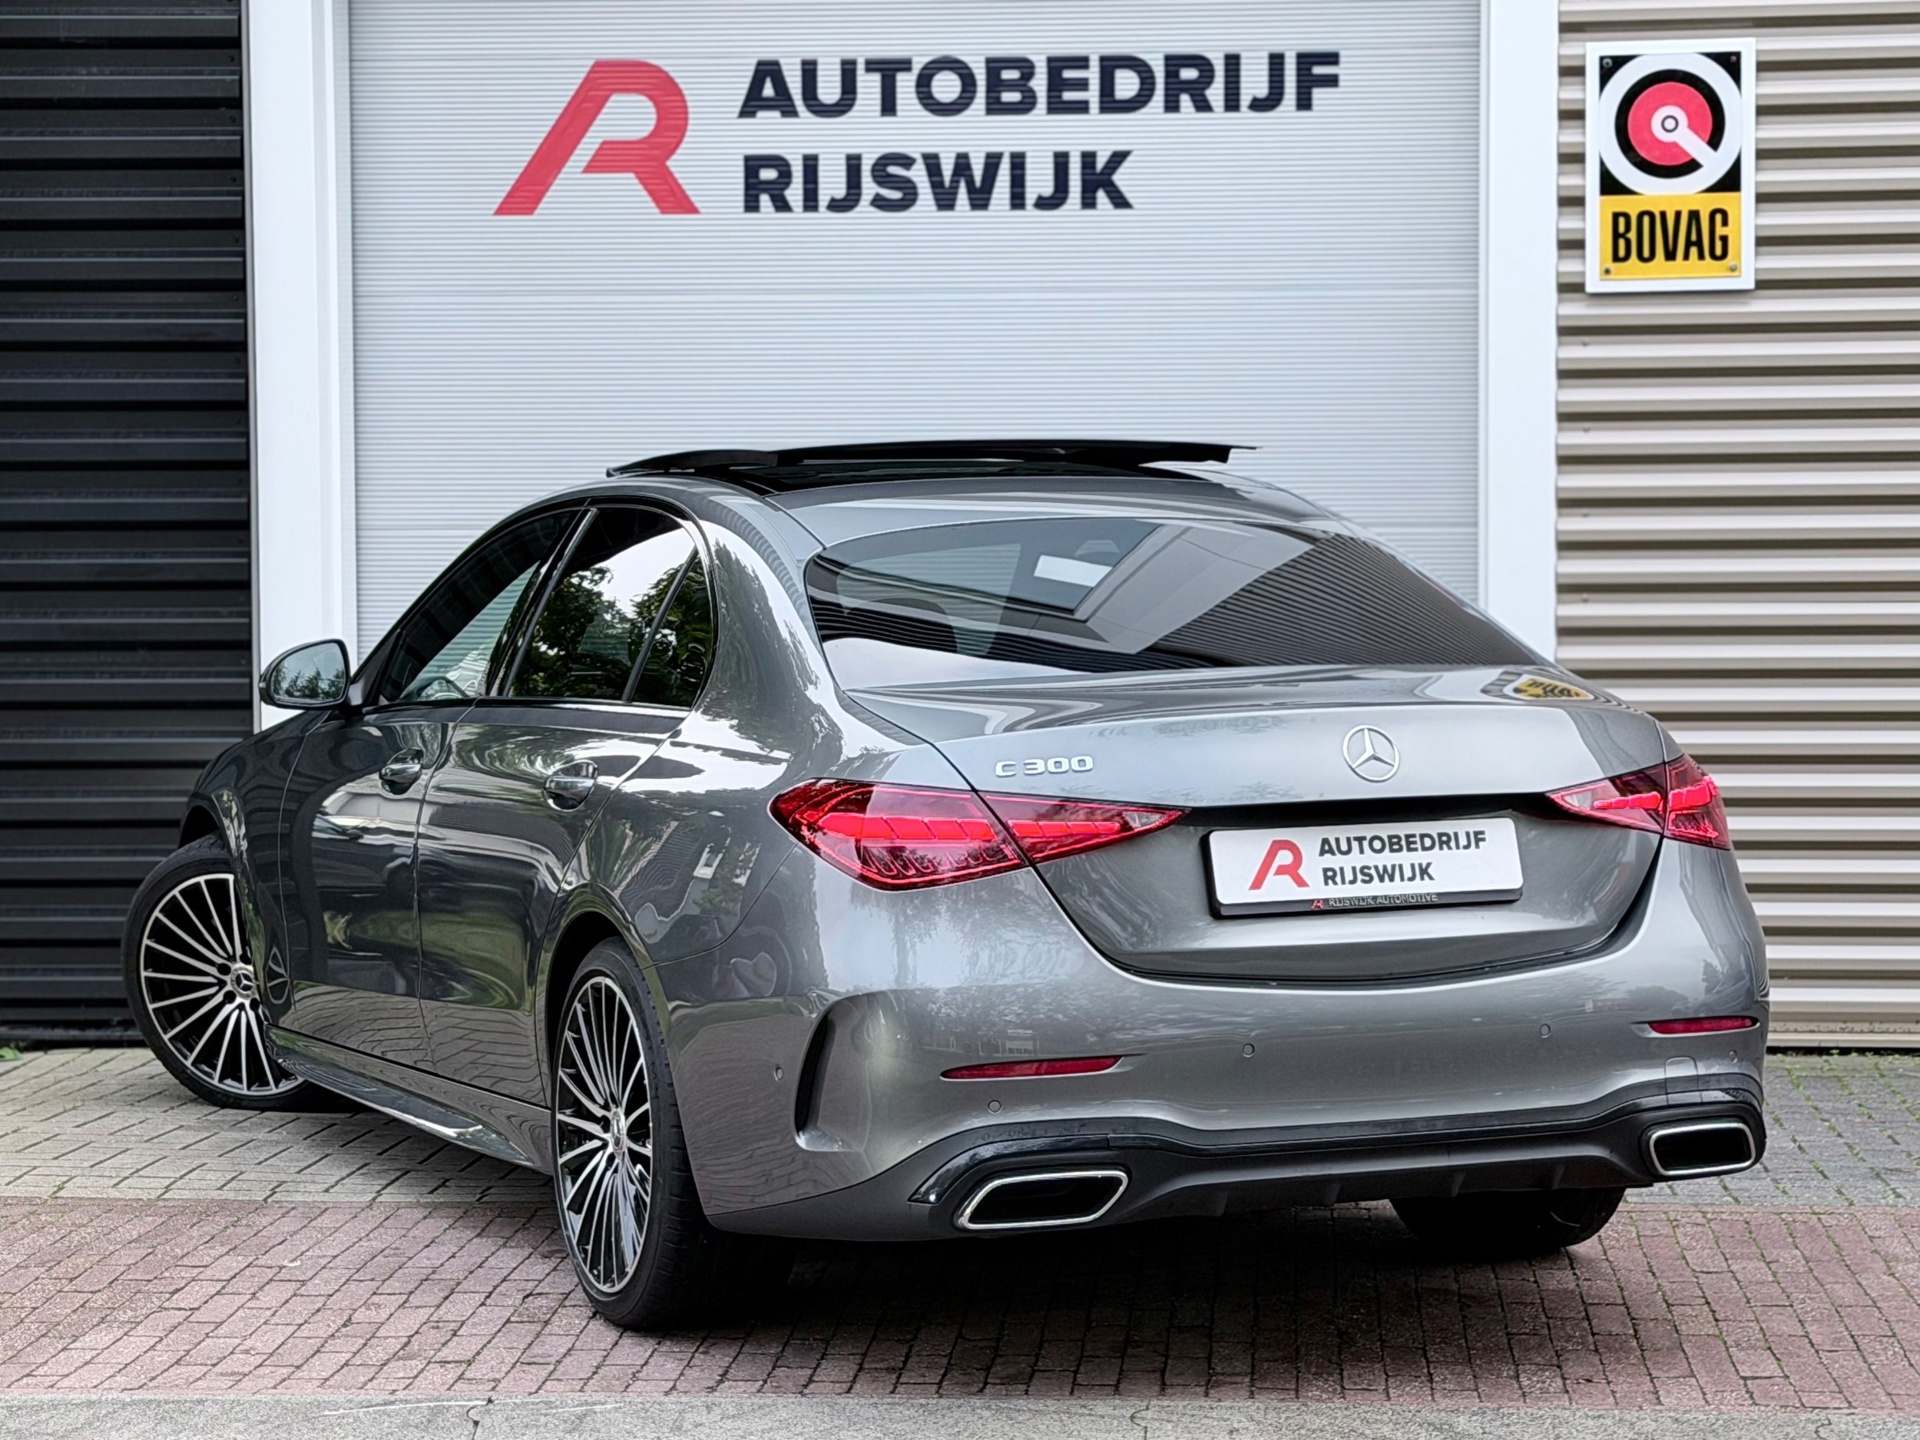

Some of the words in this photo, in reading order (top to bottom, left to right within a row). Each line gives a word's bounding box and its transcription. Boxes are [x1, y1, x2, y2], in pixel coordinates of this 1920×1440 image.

[737, 51, 1341, 119] AUTOBEDRIJF
[742, 149, 1136, 213] RIJSWIJK
[1611, 208, 1730, 264] BOVAG
[995, 761, 1016, 778] C
[1023, 755, 1094, 776] 300
[1318, 829, 1487, 857] AUTOBEDRIJF
[1322, 861, 1436, 887] RIJSWIJK
[1375, 893, 1439, 906] AUTOMOTIVE
